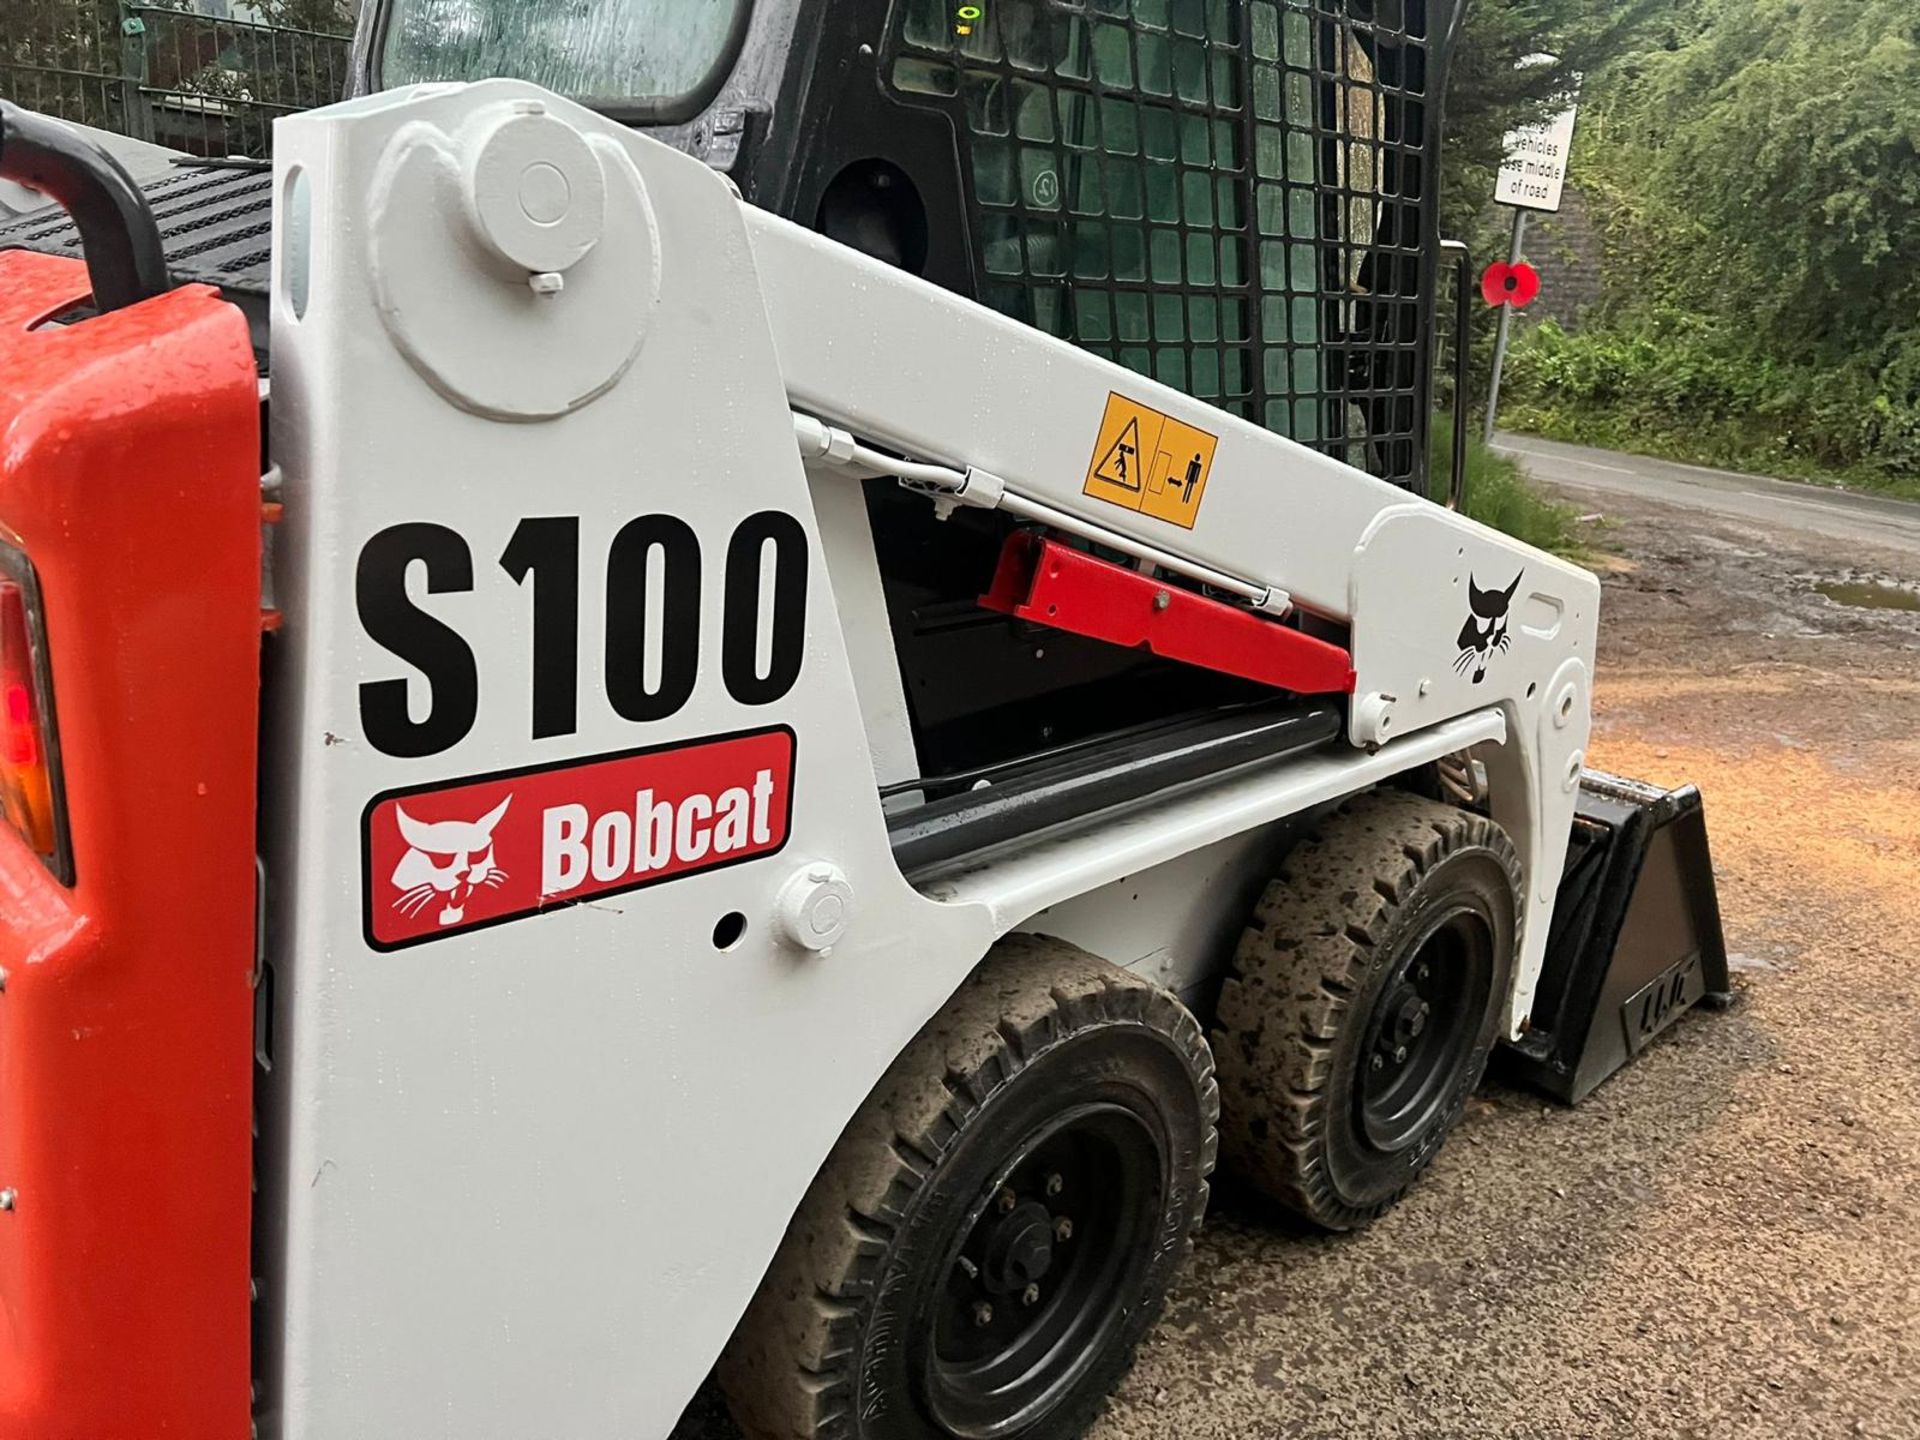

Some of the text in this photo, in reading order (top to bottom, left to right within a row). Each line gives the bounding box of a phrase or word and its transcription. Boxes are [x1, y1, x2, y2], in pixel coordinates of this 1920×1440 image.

[1511, 179, 1548, 199] of road
[1525, 159, 1561, 179] middle
[356, 510, 809, 758] S100
[542, 769, 774, 895] Bobcat
